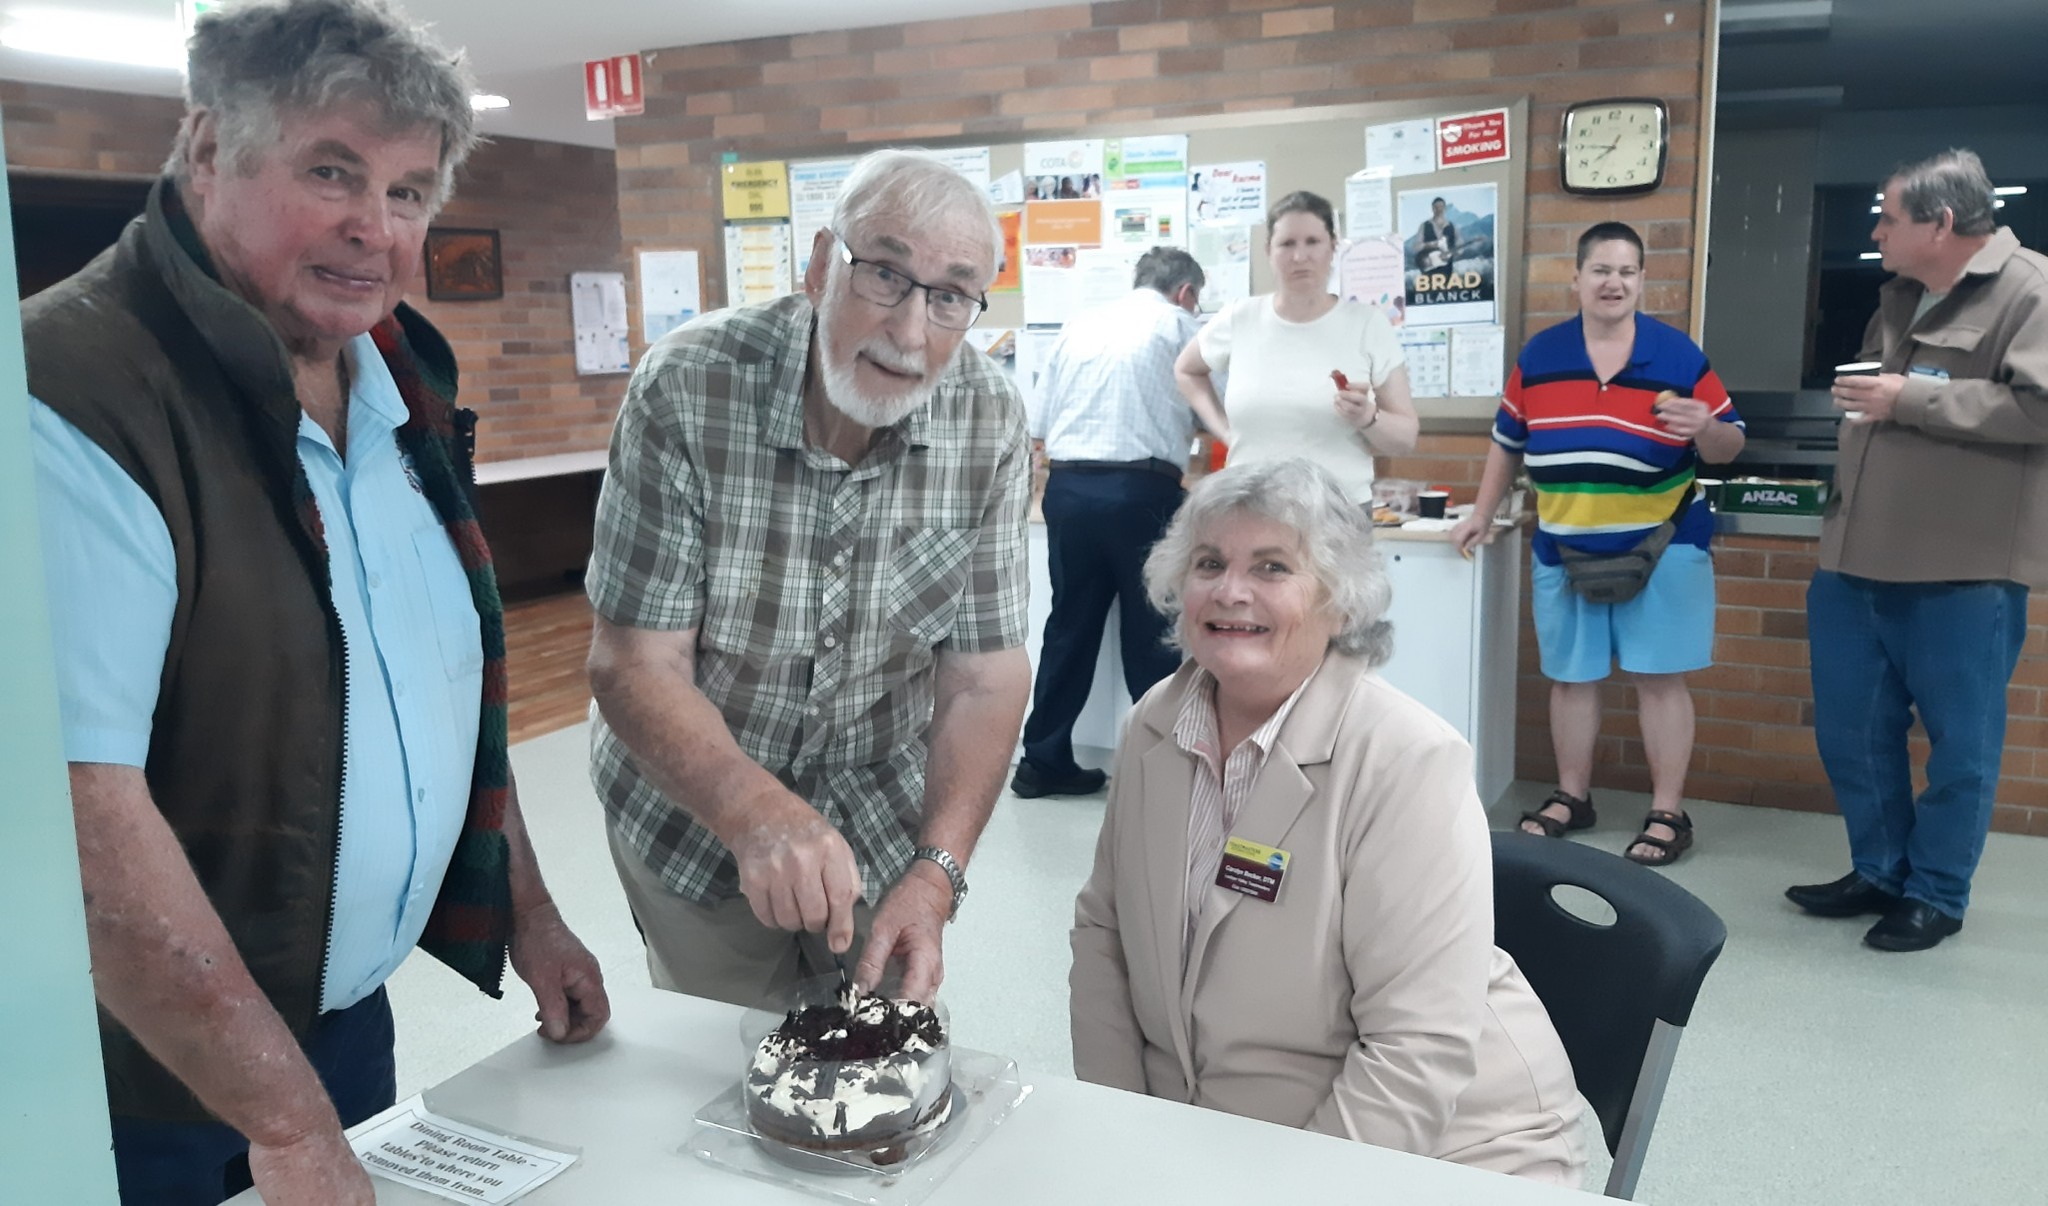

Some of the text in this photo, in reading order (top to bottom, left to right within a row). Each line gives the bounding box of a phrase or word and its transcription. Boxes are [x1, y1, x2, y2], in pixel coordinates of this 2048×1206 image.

[1608, 109, 1622, 120] 12
[1592, 116, 1601, 124] 11
[1463, 121, 1486, 131] Thank
[1639, 124, 1649, 134] 2
[1468, 131, 1481, 139] For
[1579, 128, 1592, 137] 10
[1446, 140, 1502, 157] SMOKING
[1575, 143, 1585, 152] 9
[1643, 140, 1653, 150] 3
[1040, 157, 1067, 169] COTA
[1579, 159, 1588, 168] 8
[1212, 169, 1233, 178] Dear
[1592, 171, 1599, 181] 7
[1626, 170, 1635, 180] 5
[1607, 174, 1617, 184] 6
[731, 180, 778, 189] EMERGENCY
[1415, 271, 1482, 292] BRAD
[1415, 290, 1481, 304] BLANCK
[1741, 490, 1798, 505] ANZAC
[1263, 876, 1276, 885] DTM
[410, 1122, 455, 1143] Dining
[452, 1137, 491, 1154] Room
[492, 1149, 528, 1165] Table
[414, 1139, 501, 1171] Please return
[380, 1142, 504, 1188] tables to where you
[361, 1152, 486, 1198] removed them from.
